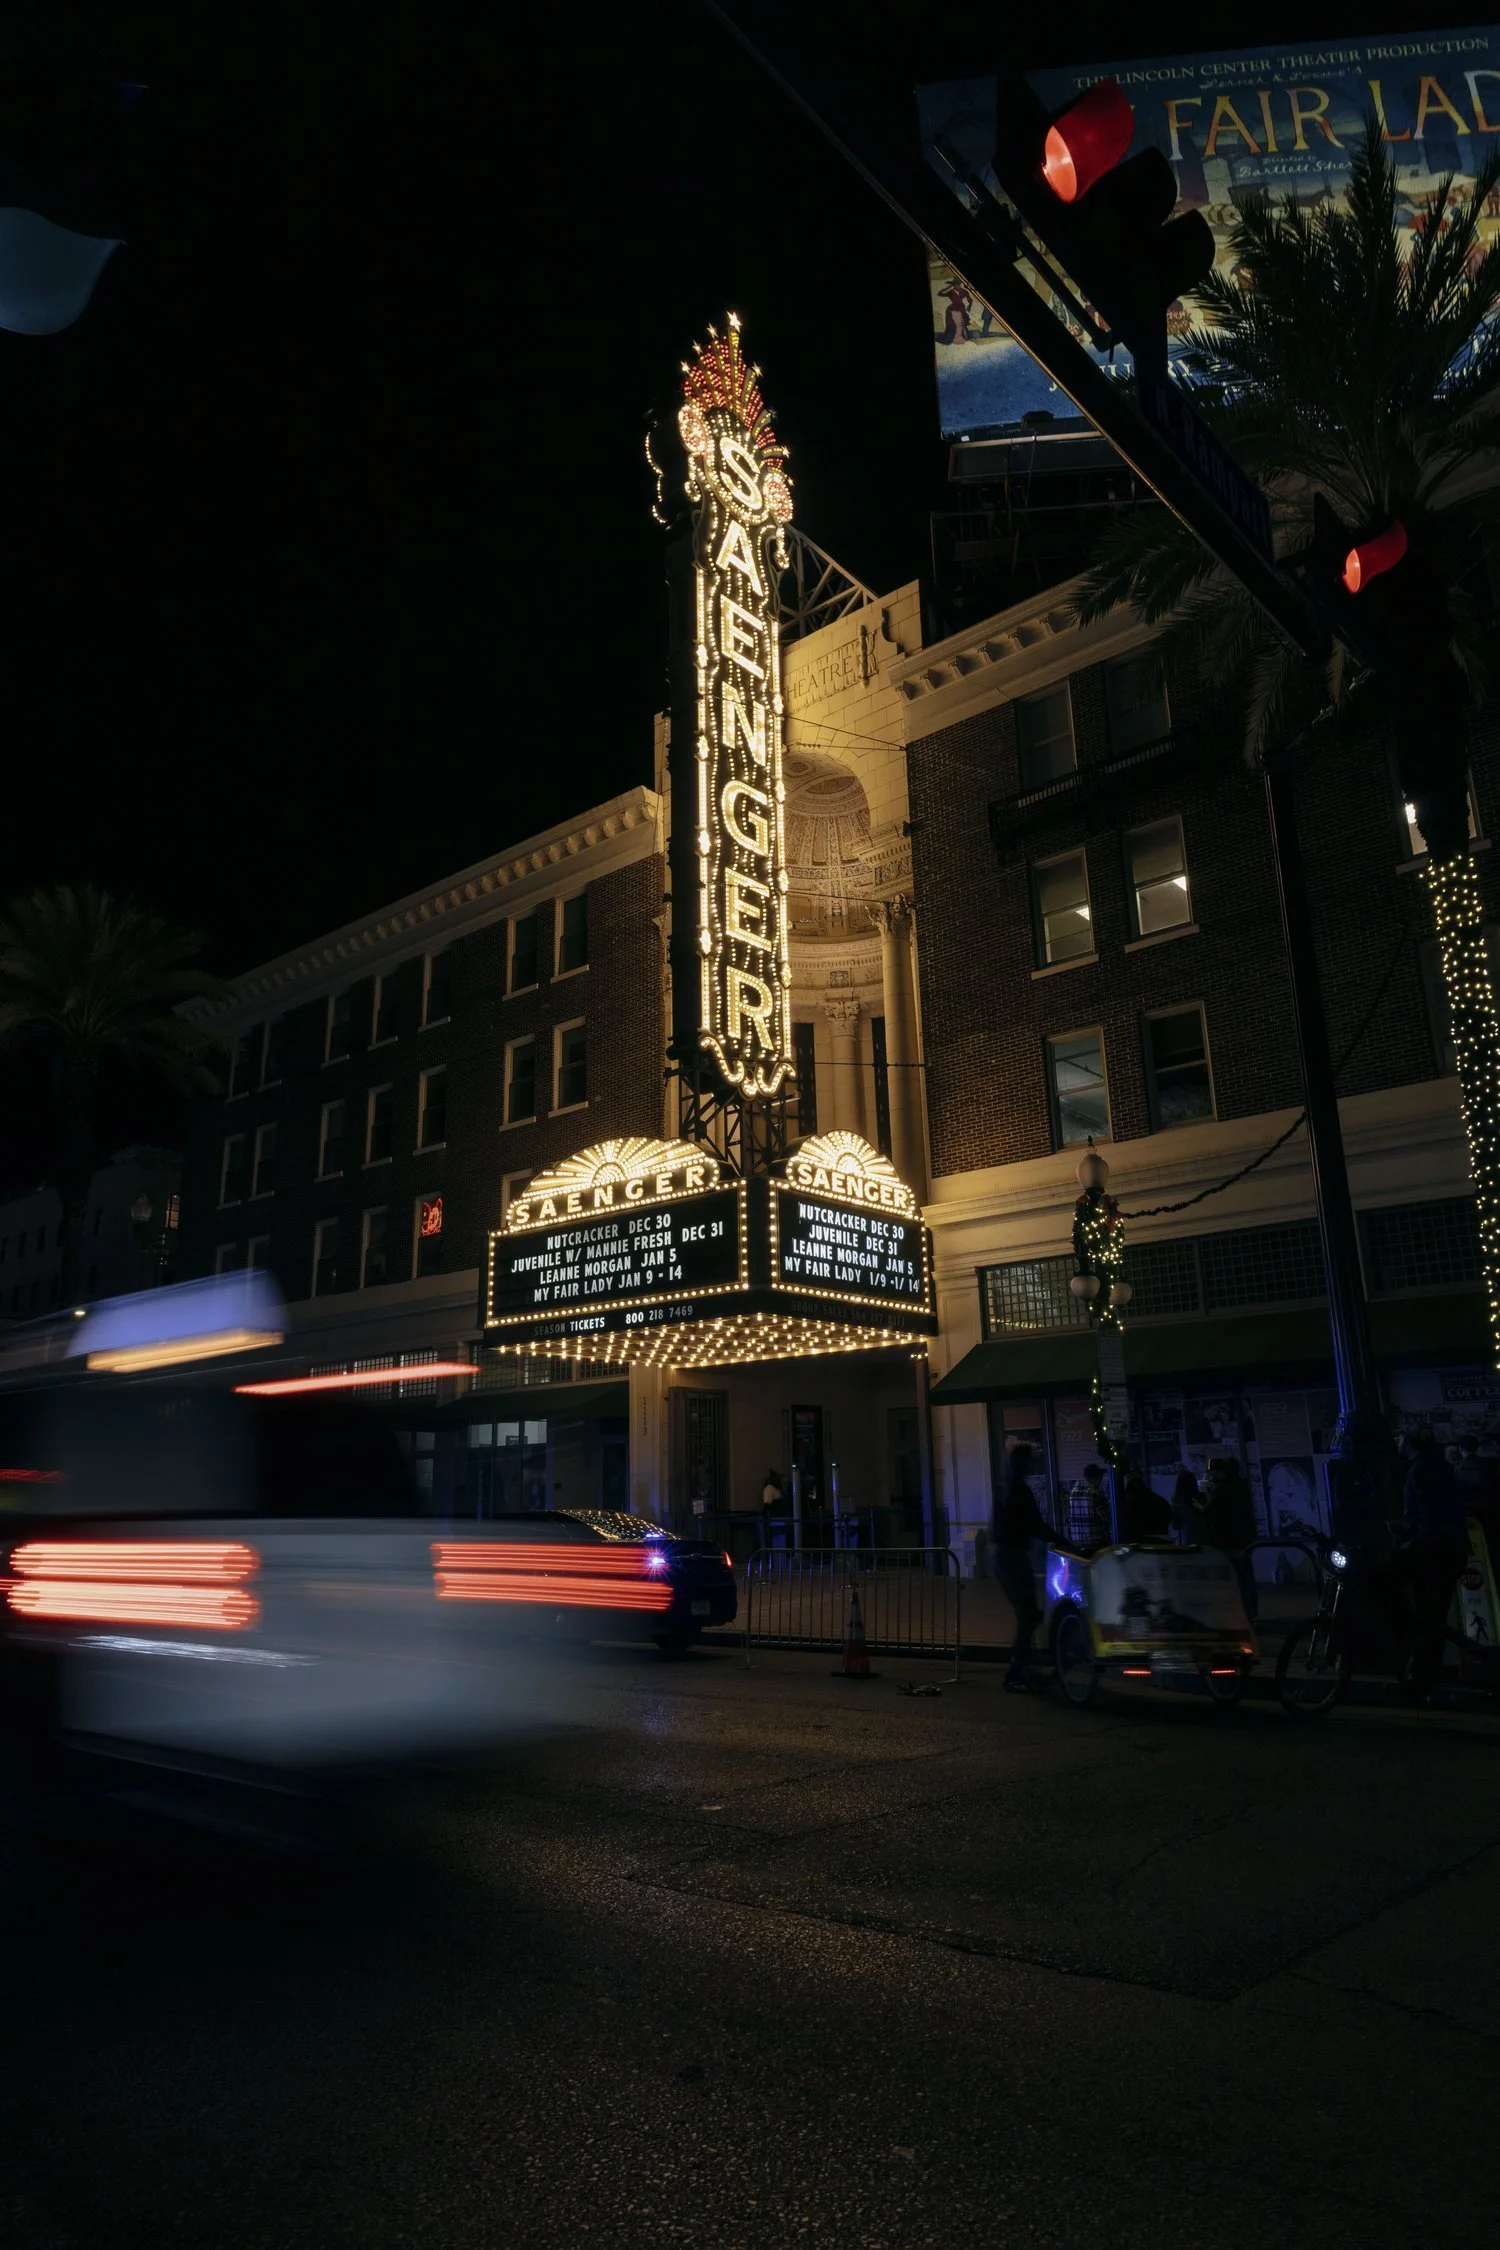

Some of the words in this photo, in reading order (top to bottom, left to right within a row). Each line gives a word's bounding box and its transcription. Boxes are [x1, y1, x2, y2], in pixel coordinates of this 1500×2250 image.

[1073, 74, 1109, 89] TH
[1115, 66, 1195, 85] LINCOLN
[1200, 59, 1272, 76] CENTER
[1277, 49, 1361, 69] THEATER
[1367, 37, 1489, 61] PRODUCTION
[1164, 86, 1345, 161] FAIR
[783, 656, 854, 703] HEATRE
[716, 435, 775, 1052] SAENGER
[516, 1165, 705, 1224] SAENGER
[798, 1163, 907, 1209] SAENGER
[547, 1223, 619, 1250] NUTCRACKER
[629, 1217, 651, 1234] DEC
[656, 1213, 671, 1229] 30
[799, 1203, 867, 1232] NUTCRACKER
[871, 1220, 889, 1237] DEC
[892, 1224, 904, 1240] 30
[809, 1224, 858, 1248] JUVENILE
[866, 1236, 884, 1253] DEC
[888, 1241, 898, 1256] 31
[511, 1252, 561, 1274] JUVENILE
[566, 1248, 581, 1263] W/
[587, 1238, 629, 1260] MANNIE
[634, 1230, 672, 1251] FRESH
[682, 1225, 706, 1243] DEC
[711, 1221, 723, 1238] 31
[793, 1238, 832, 1261] LEANNE
[837, 1247, 878, 1269] MORGAN
[886, 1258, 904, 1275] JAN
[907, 1261, 913, 1275] 5
[534, 1287, 549, 1303] MY
[554, 1282, 579, 1299] FAIR
[584, 1276, 613, 1295] LADY
[618, 1272, 641, 1289] JAN
[646, 1269, 654, 1285] 9
[669, 1265, 682, 1281] 14
[540, 1265, 580, 1285] LEANNE
[584, 1255, 631, 1277] MORGAN
[641, 1250, 664, 1267] JAN
[669, 1248, 677, 1263] 5
[785, 1256, 801, 1272] MY
[805, 1259, 831, 1278] FAIR
[835, 1265, 861, 1283] LADY
[870, 1271, 886, 1287] 1/9
[909, 1278, 919, 1293] 14
[534, 1321, 566, 1337] SEASON
[570, 1316, 606, 1333] TICKETS
[625, 1311, 644, 1326] 800
[648, 1308, 664, 1321] 218
[669, 1305, 693, 1318] 7469
[791, 1301, 818, 1315] GROUP
[823, 1305, 847, 1319] SALES
[1060, 1430, 1083, 1442] 1927
